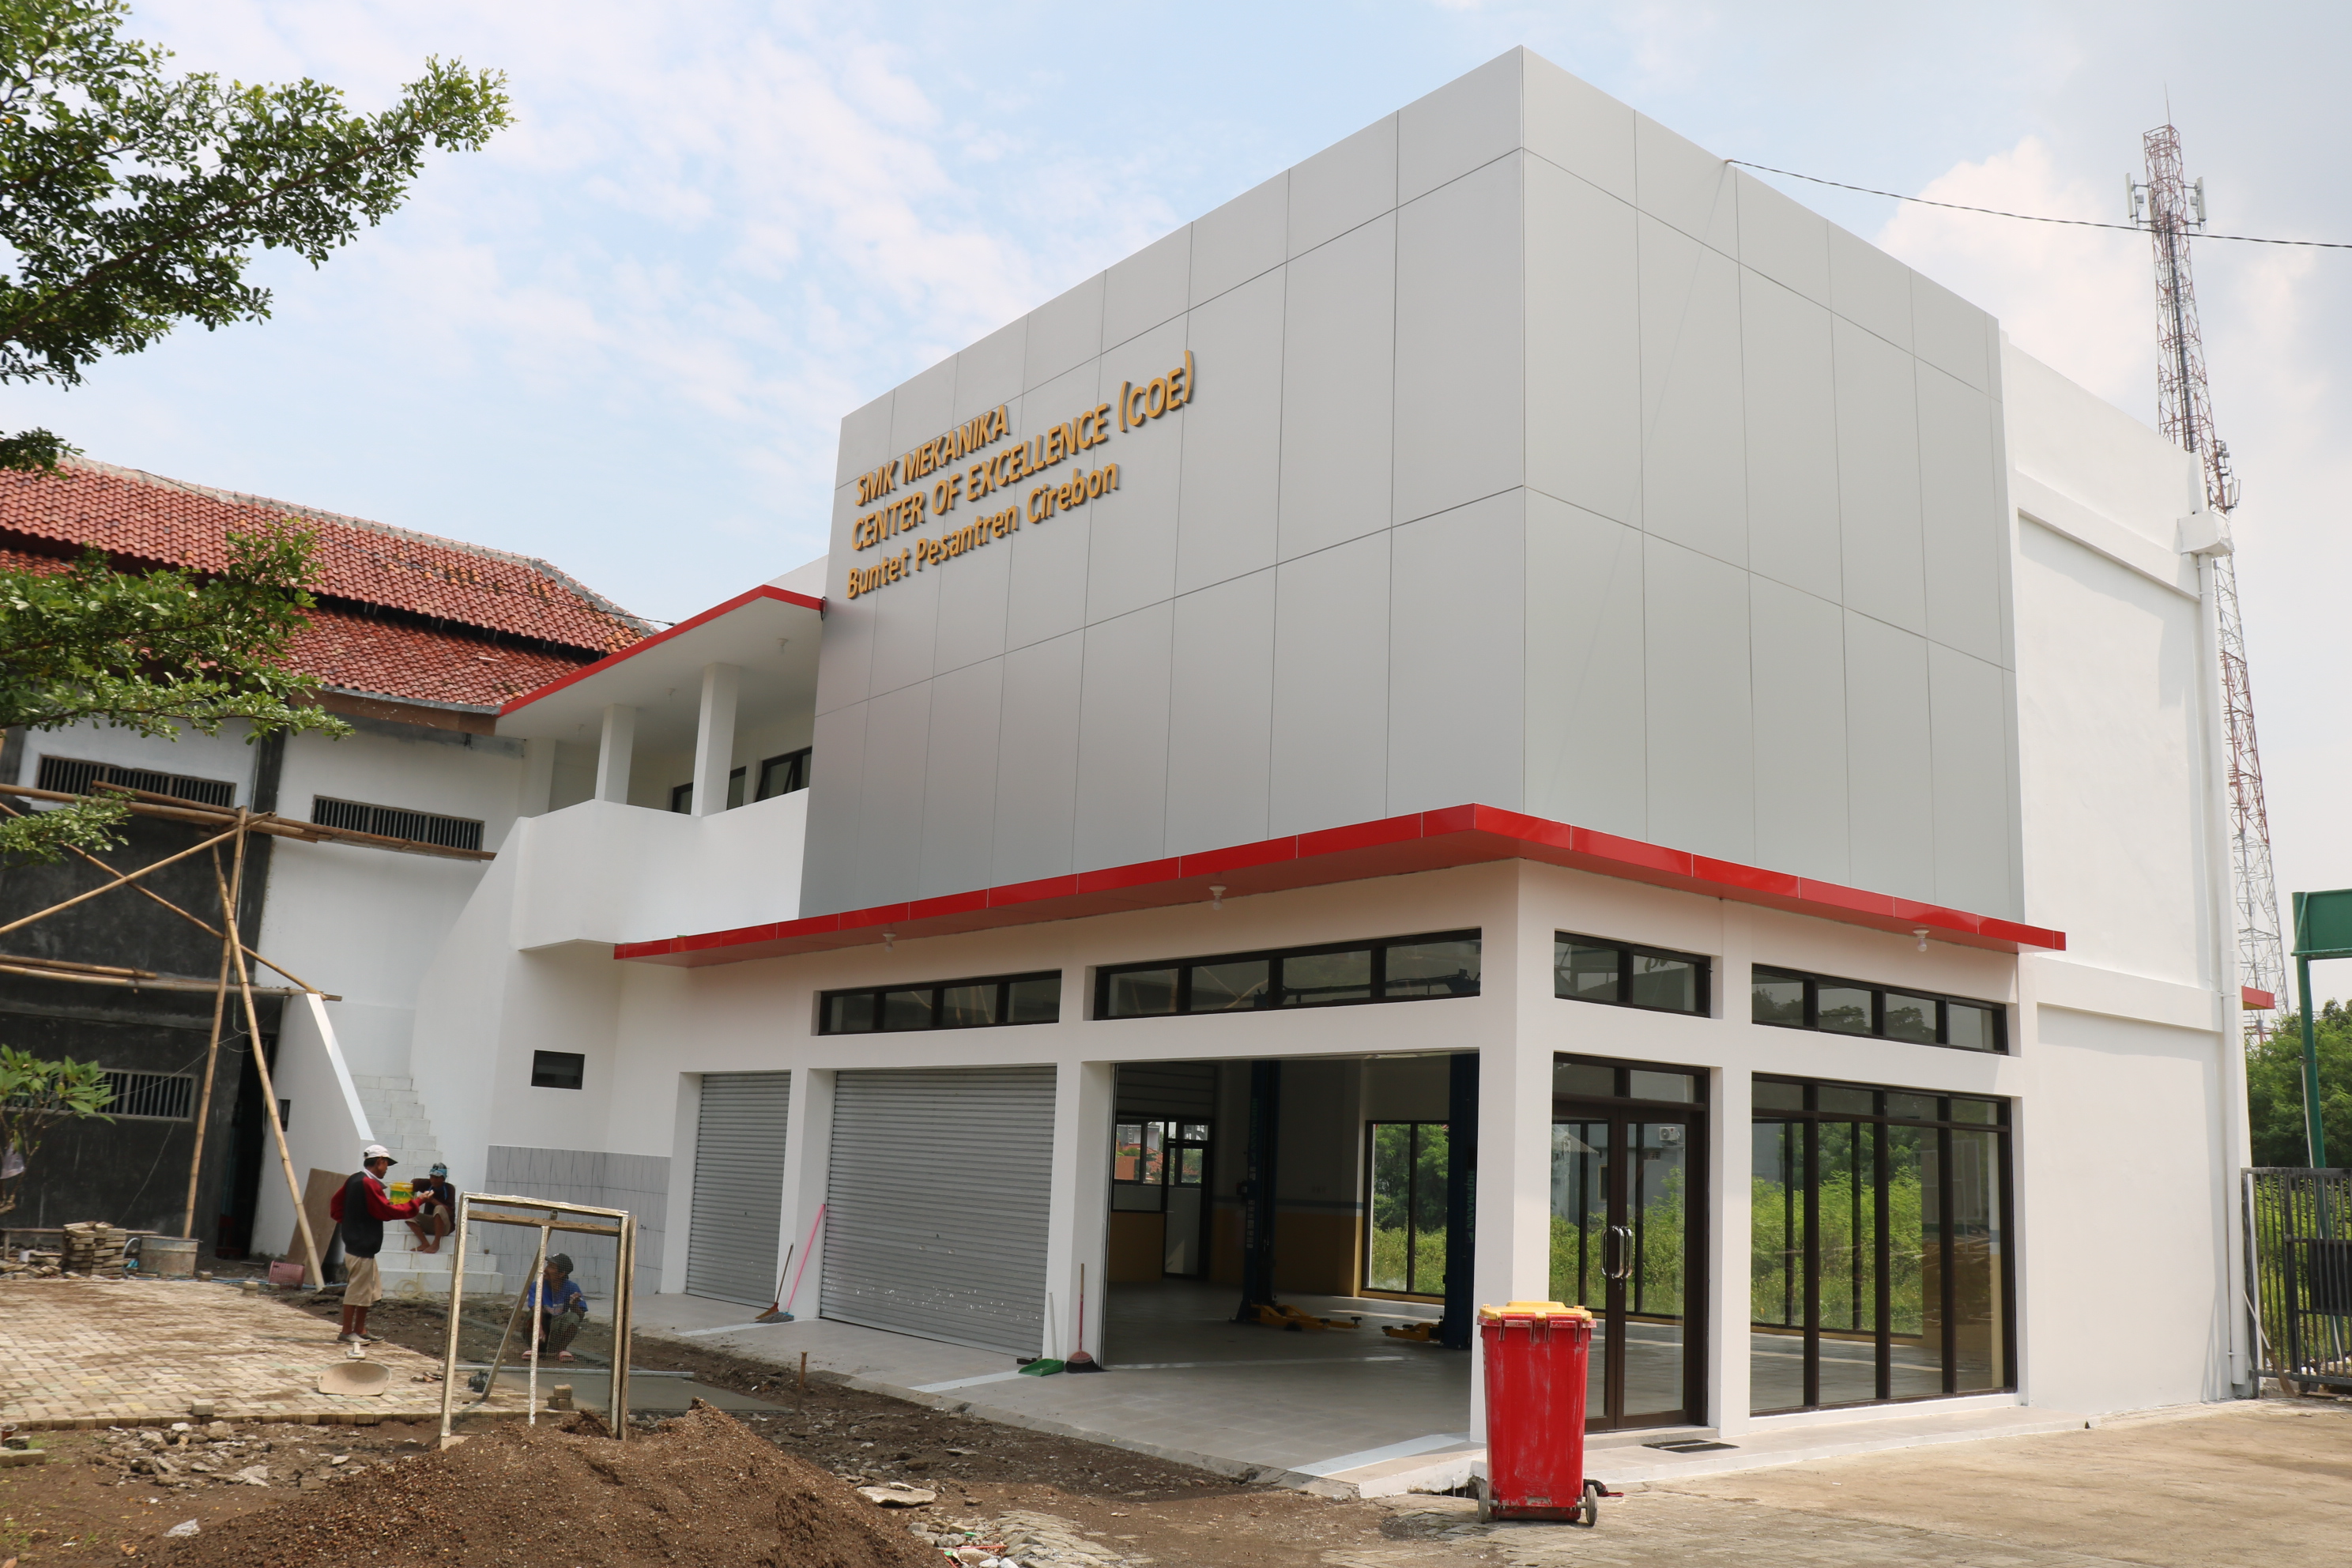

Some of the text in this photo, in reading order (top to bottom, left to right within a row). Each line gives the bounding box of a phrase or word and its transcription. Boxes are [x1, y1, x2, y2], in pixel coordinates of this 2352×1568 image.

[851, 349, 1194, 551] CENTER OF EXCELLENCE (COE)
[855, 404, 1009, 507] SMK MEKANIKA
[846, 462, 1118, 599] Buntet Pesantren Cirebon
[1466, 1170, 1476, 1229] HOFMANN
